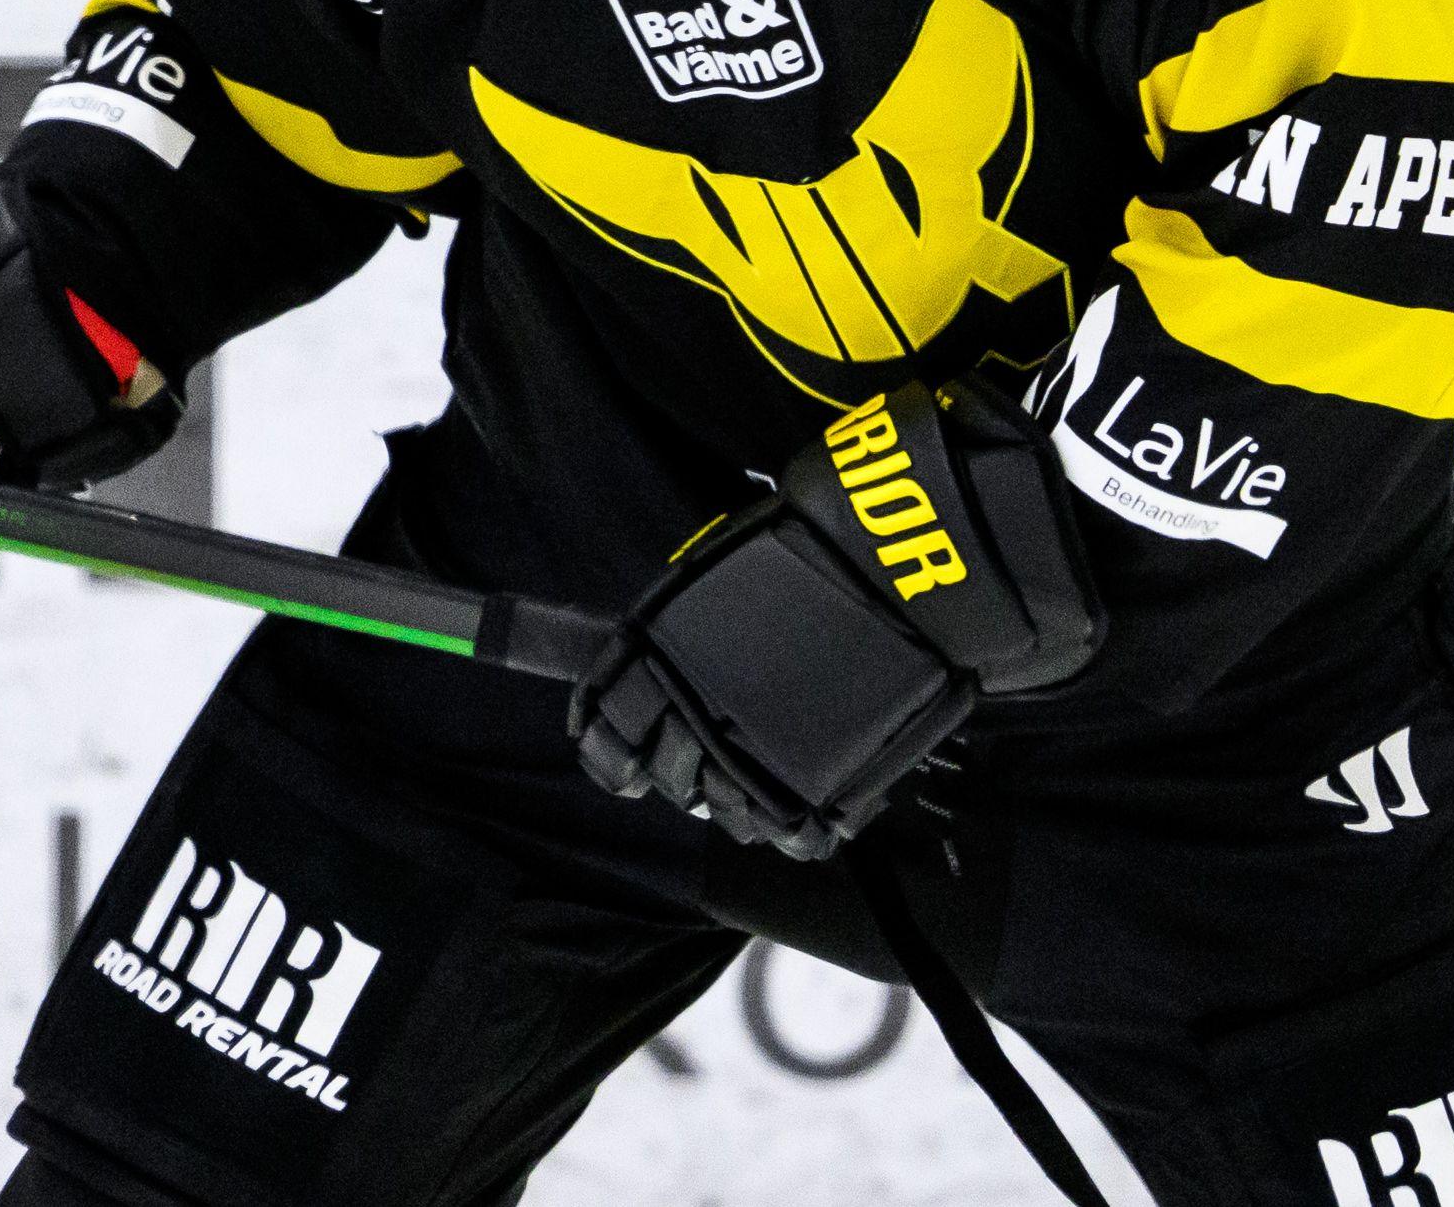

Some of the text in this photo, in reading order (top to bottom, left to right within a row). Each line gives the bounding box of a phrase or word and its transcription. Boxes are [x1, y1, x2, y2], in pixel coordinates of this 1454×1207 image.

[635, 2, 726, 48] Bad
[1094, 376, 1287, 507] LaVie
[93, 939, 350, 1112] ROAD RENTAL
